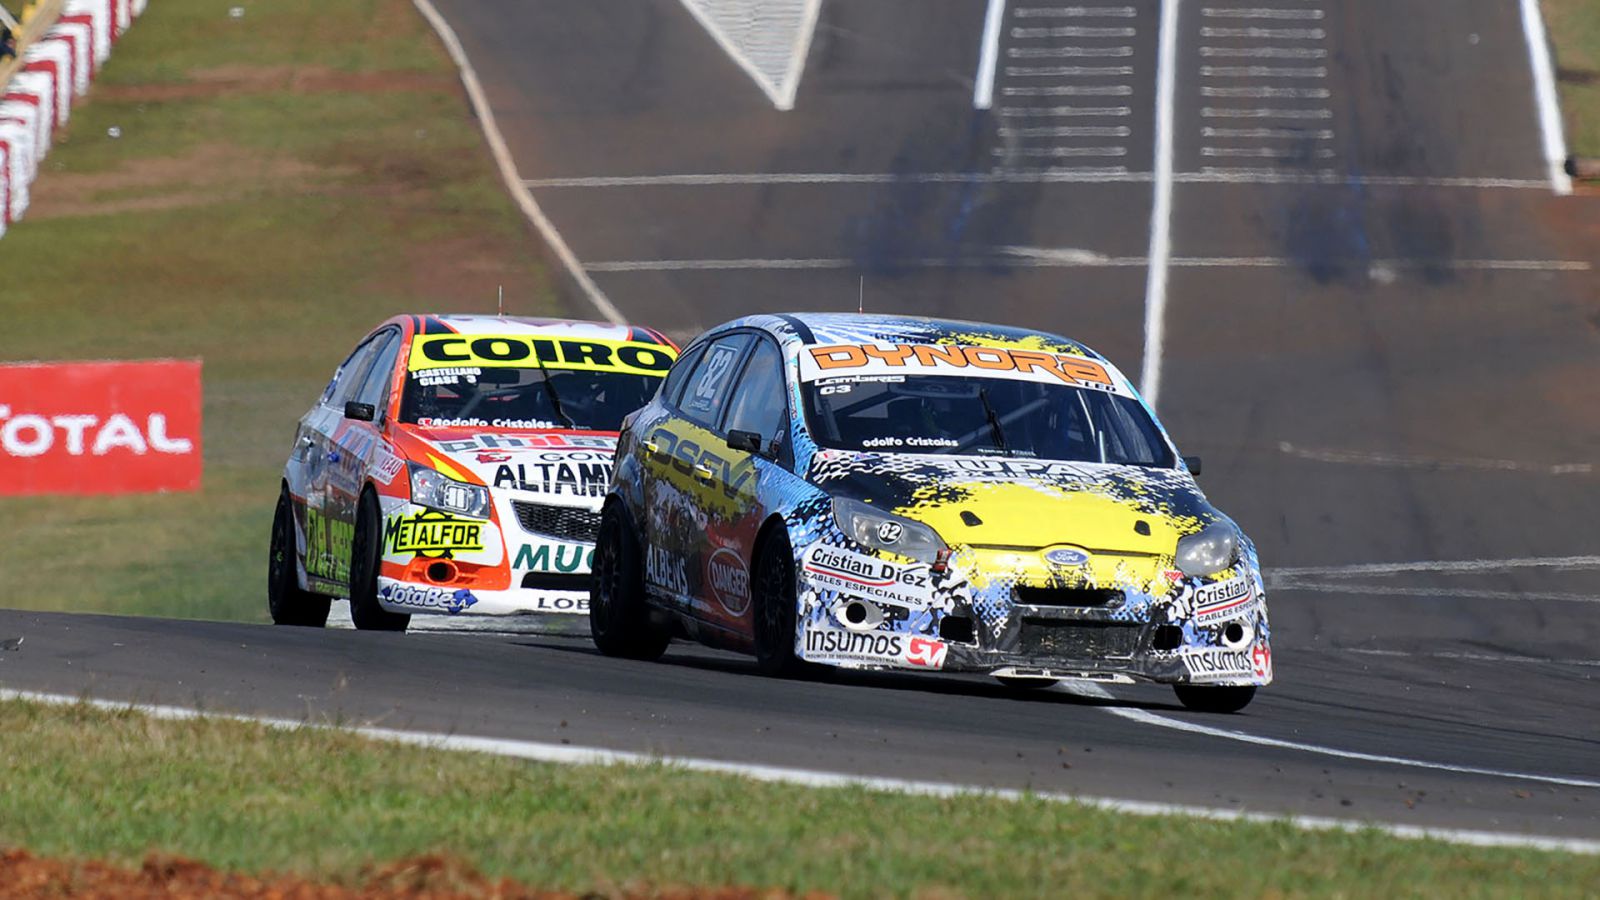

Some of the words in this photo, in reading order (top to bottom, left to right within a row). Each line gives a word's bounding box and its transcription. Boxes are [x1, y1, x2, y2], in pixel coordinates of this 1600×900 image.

[422, 338, 676, 371] COIRO
[696, 350, 732, 399] 82
[0, 404, 193, 457] OTAL
[492, 418, 553, 430] Cristales
[905, 437, 960, 447] Cristales
[382, 515, 482, 555] METALFOR
[879, 523, 901, 540] 82
[811, 548, 873, 576] Cristian
[711, 560, 749, 599] DANGER
[803, 571, 842, 587] CABLES
[845, 582, 923, 606] ESPECIALES
[1196, 581, 1247, 605] Cristian
[386, 583, 453, 608] JotaBe
[1198, 607, 1234, 624] CABLES
[805, 619, 902, 658] insumos
